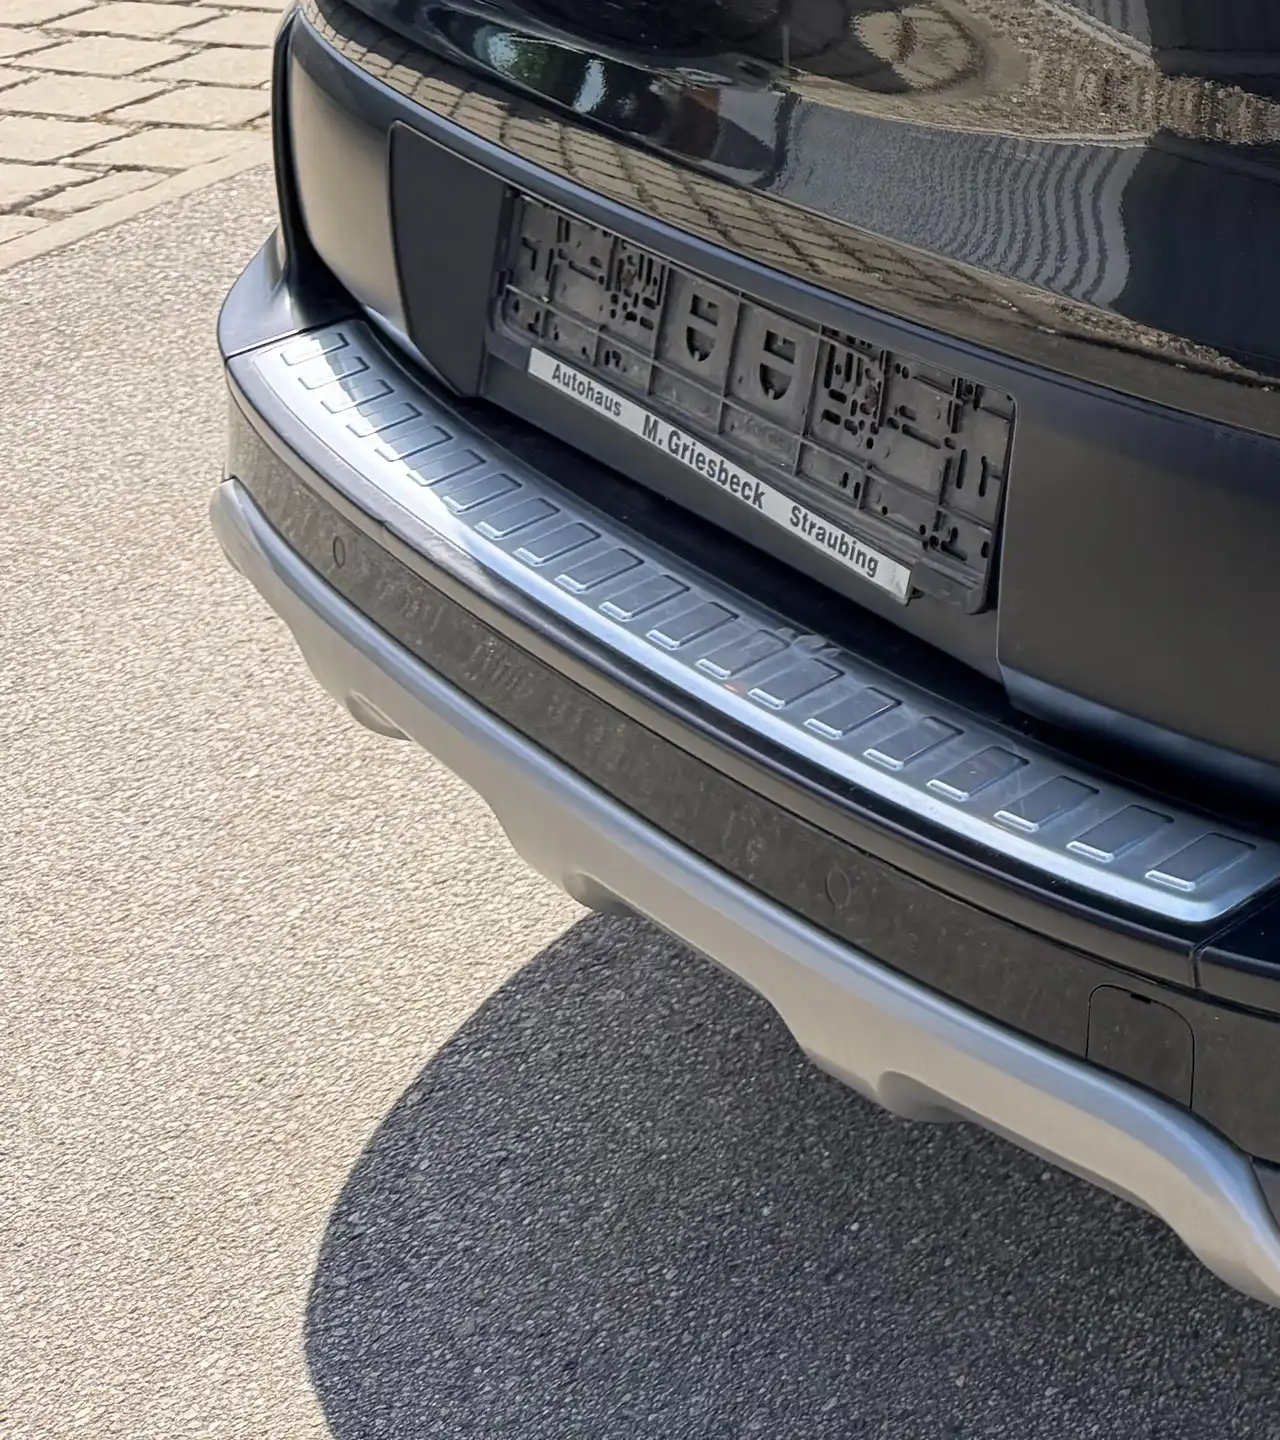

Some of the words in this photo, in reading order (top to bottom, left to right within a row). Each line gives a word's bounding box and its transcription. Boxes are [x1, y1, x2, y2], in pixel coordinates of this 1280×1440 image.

[551, 363, 622, 417] Autohaus
[642, 413, 663, 446] M.
[667, 429, 767, 511] Griesbeck
[788, 504, 879, 578] Straubing
